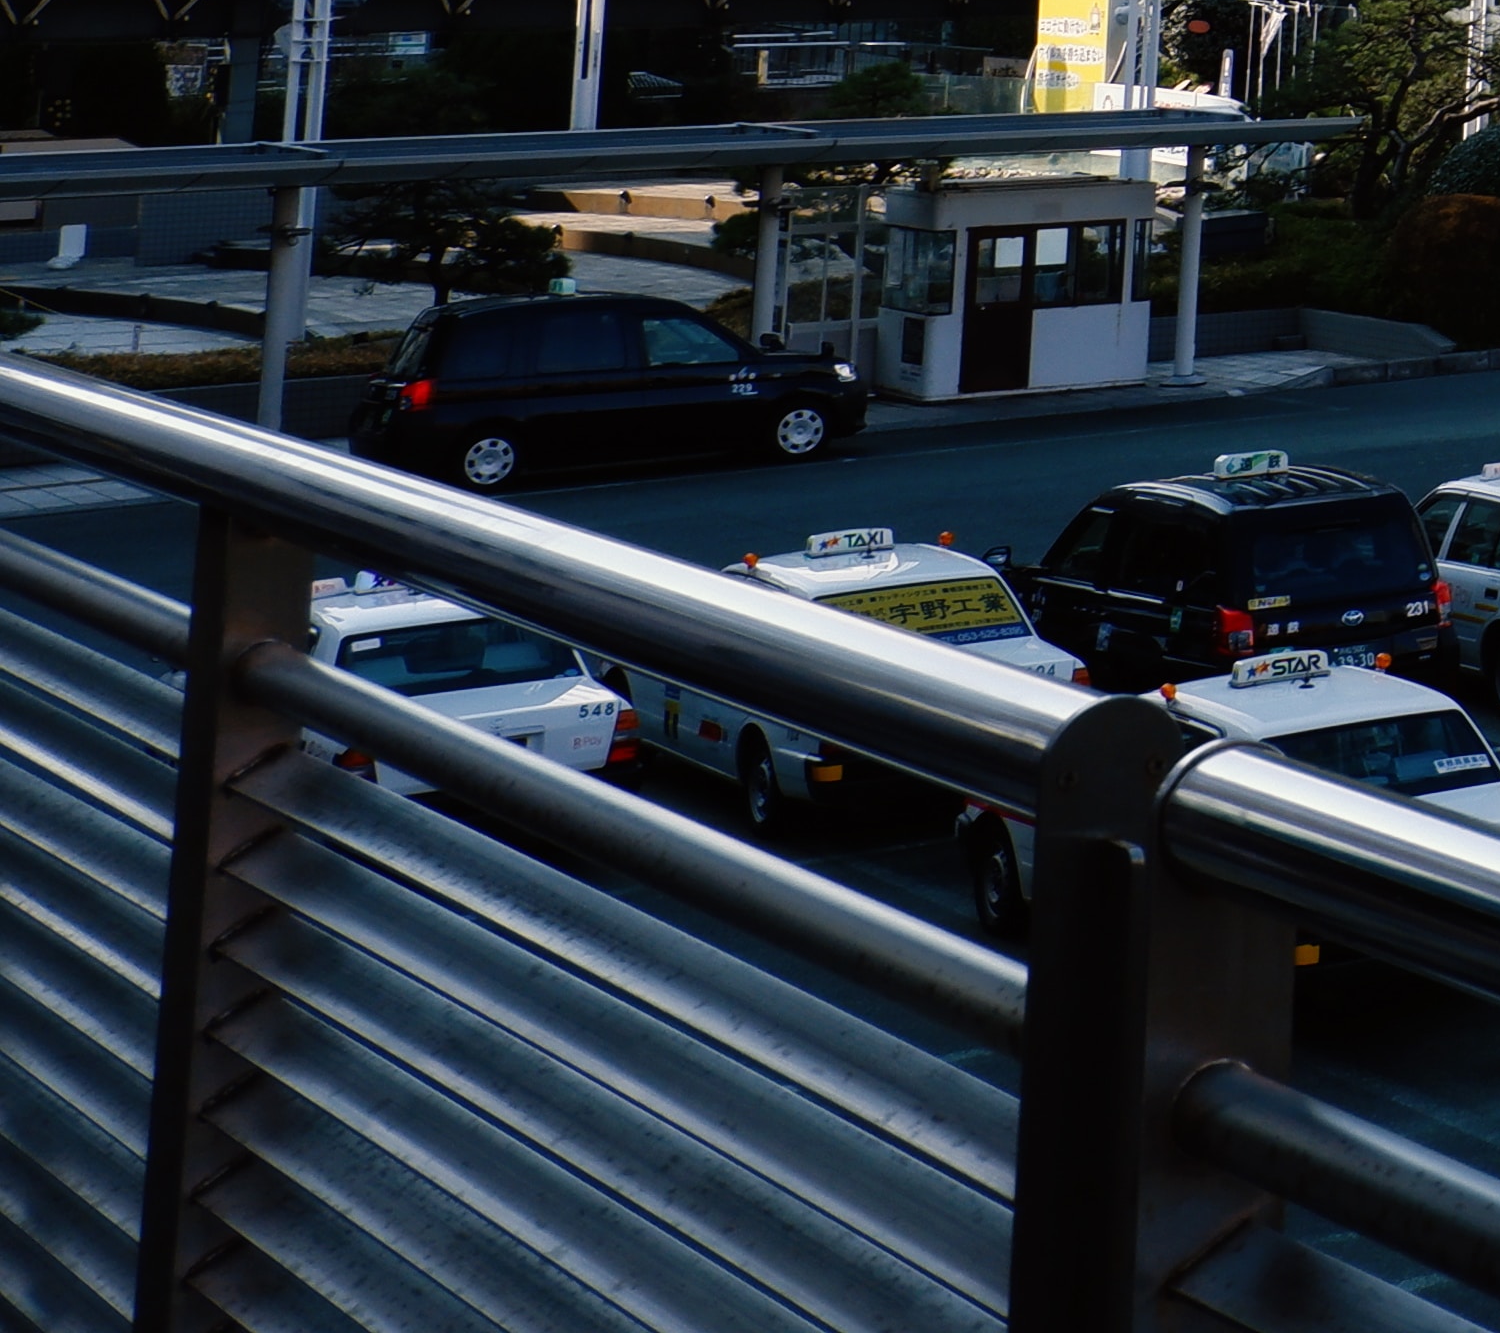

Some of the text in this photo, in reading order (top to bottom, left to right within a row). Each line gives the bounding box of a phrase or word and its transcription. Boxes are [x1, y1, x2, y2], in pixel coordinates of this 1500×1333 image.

[731, 383, 753, 393] 229
[1240, 454, 1280, 471] 遠鉄
[843, 531, 884, 548] TAXI
[890, 593, 1009, 625] 宇野工業
[1406, 601, 1429, 617] 231
[1271, 654, 1321, 677] STAR
[579, 703, 616, 719] 548
